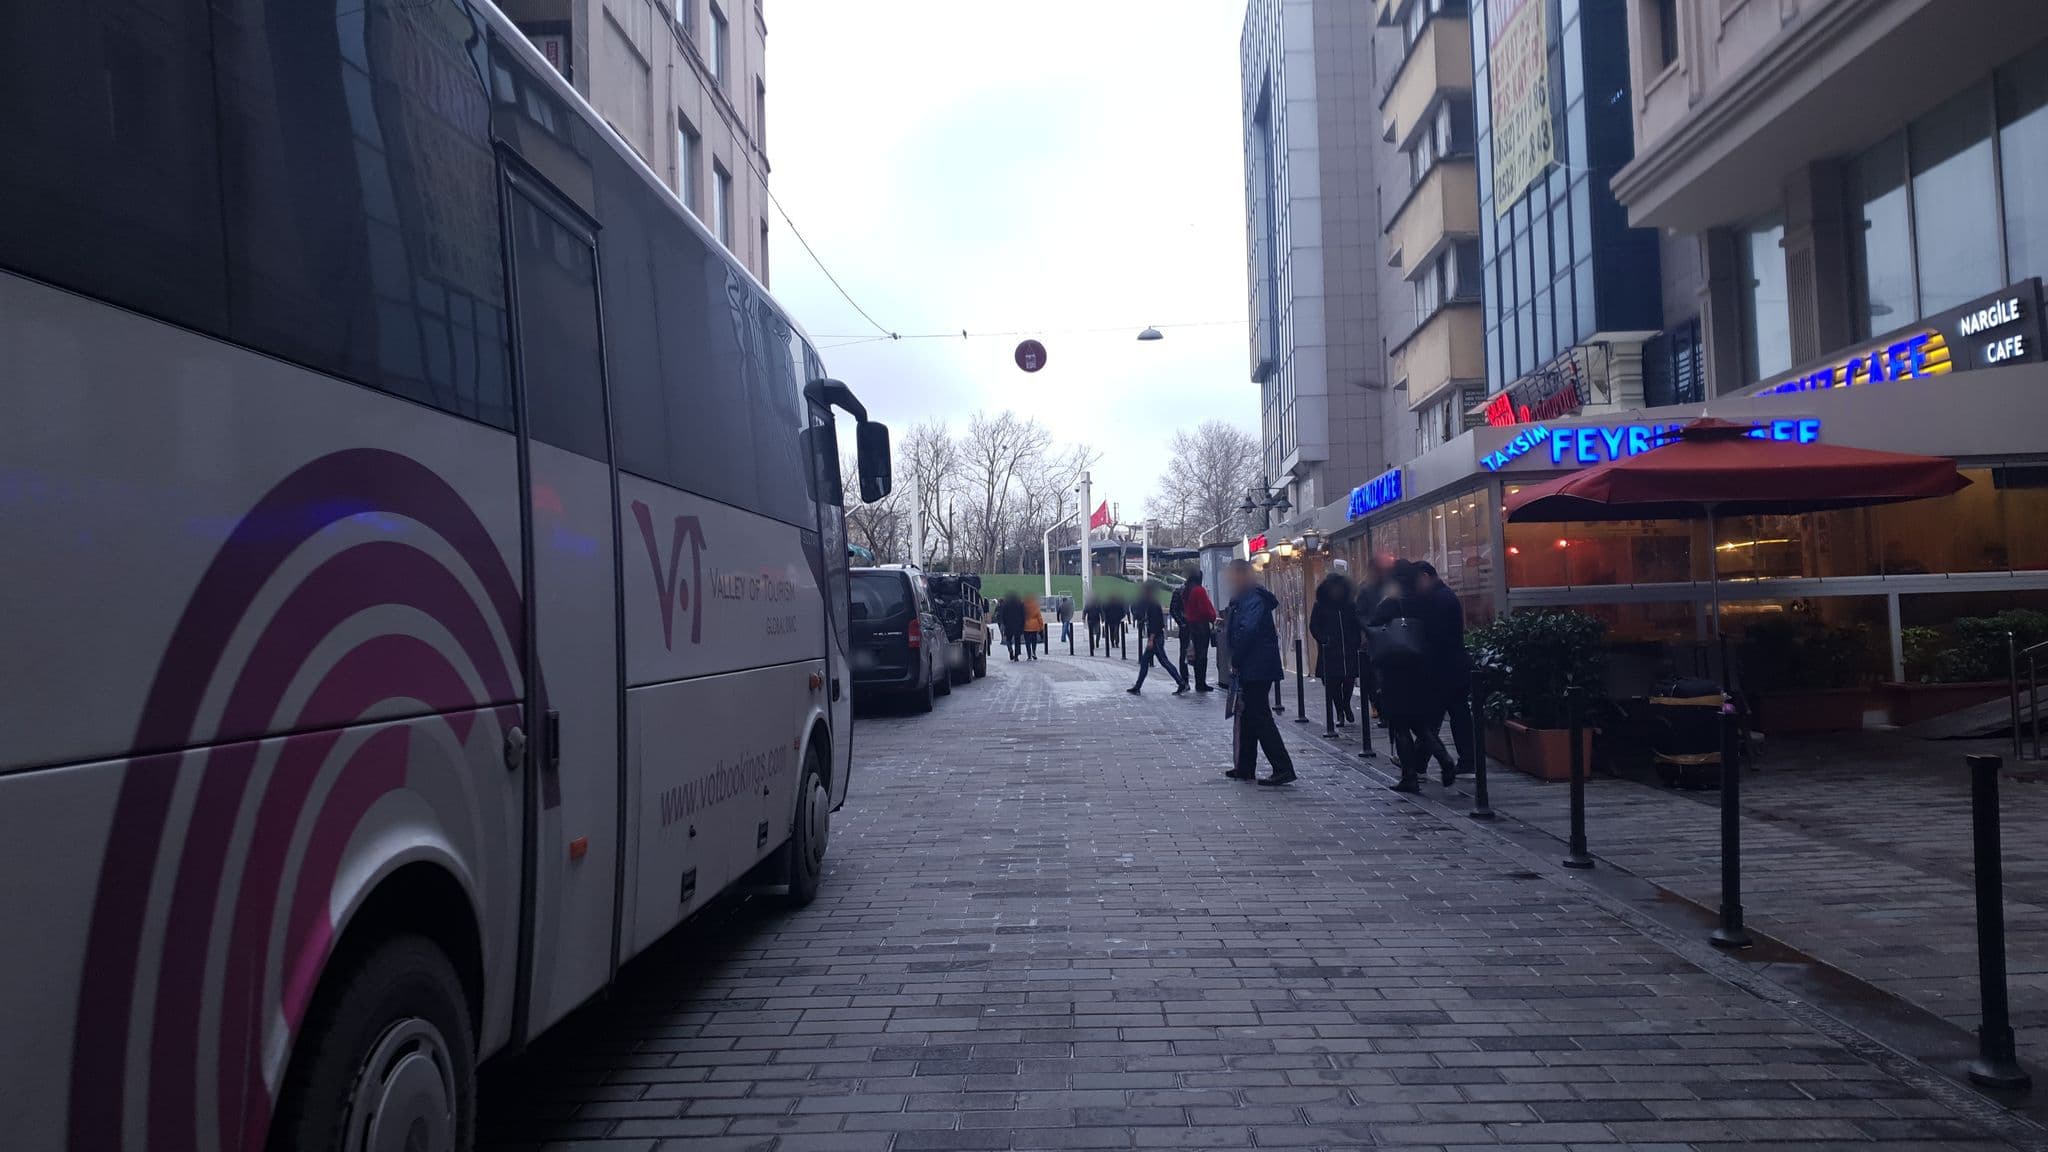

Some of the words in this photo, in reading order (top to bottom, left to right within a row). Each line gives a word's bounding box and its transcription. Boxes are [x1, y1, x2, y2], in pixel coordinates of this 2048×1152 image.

[1960, 297, 2021, 337] NARGİLE
[1986, 334, 2025, 363] CAFE
[1480, 424, 1551, 473] TAKSİM
